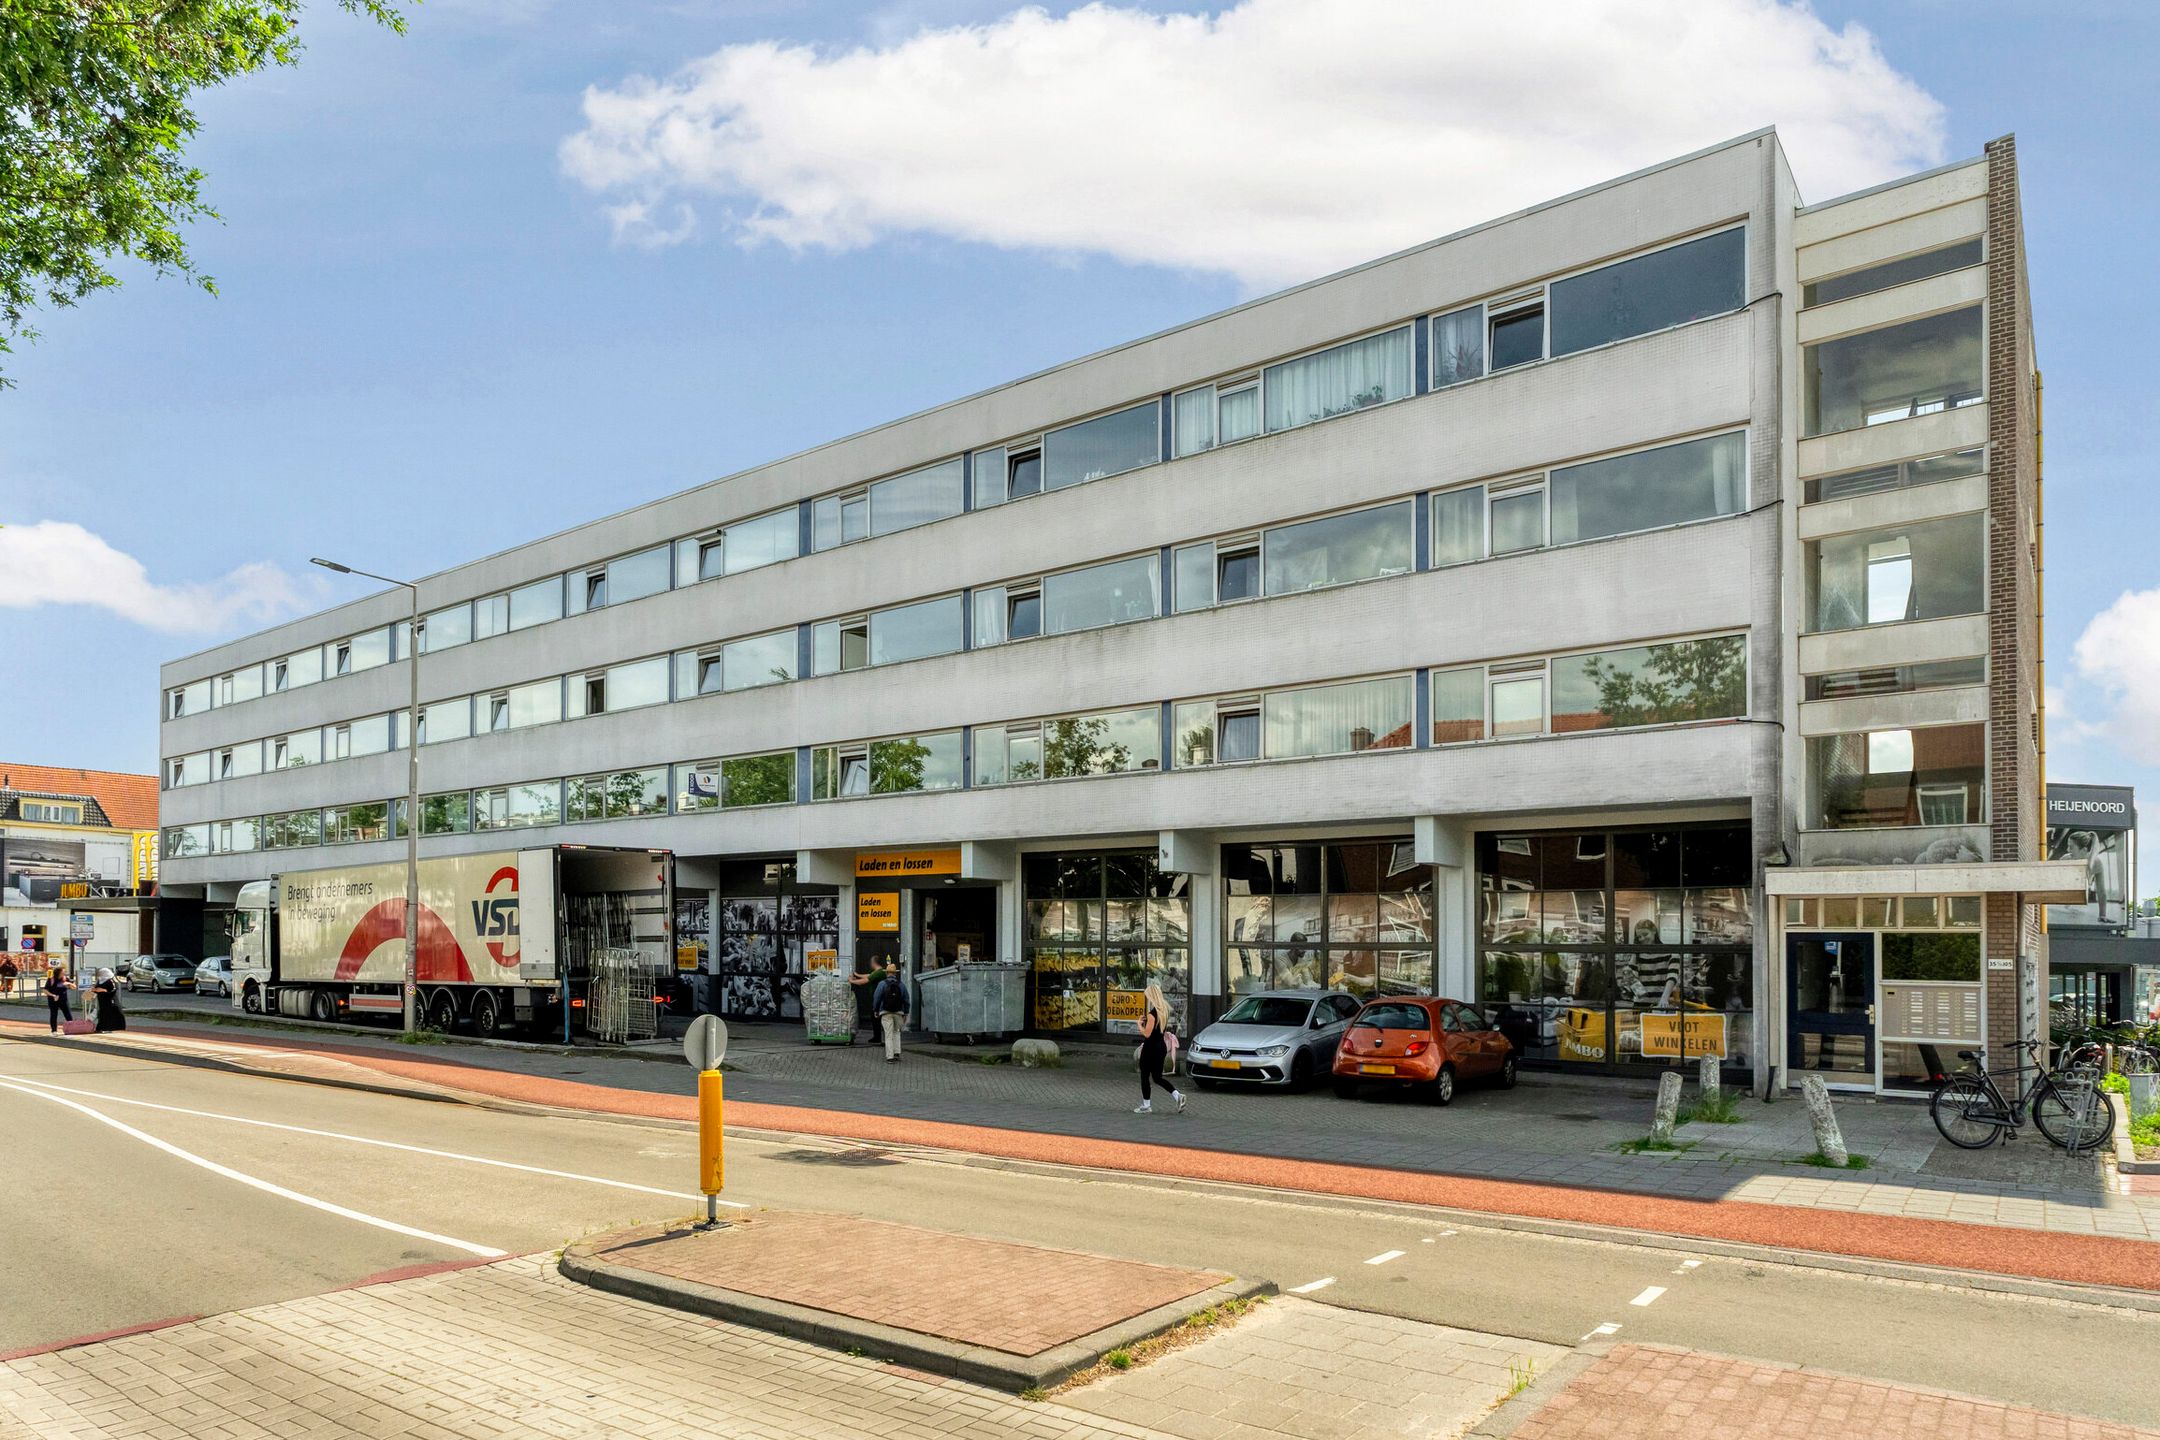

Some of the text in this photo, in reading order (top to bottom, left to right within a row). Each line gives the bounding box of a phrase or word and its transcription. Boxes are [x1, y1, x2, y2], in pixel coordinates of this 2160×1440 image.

[2049, 800, 2125, 813] HEIJENOORD
[859, 857, 933, 871] Laden en lossen
[288, 882, 373, 902] Brengt ondernemers
[860, 897, 881, 906] Laden
[288, 903, 336, 922] in beweging
[860, 909, 892, 918] en lossen
